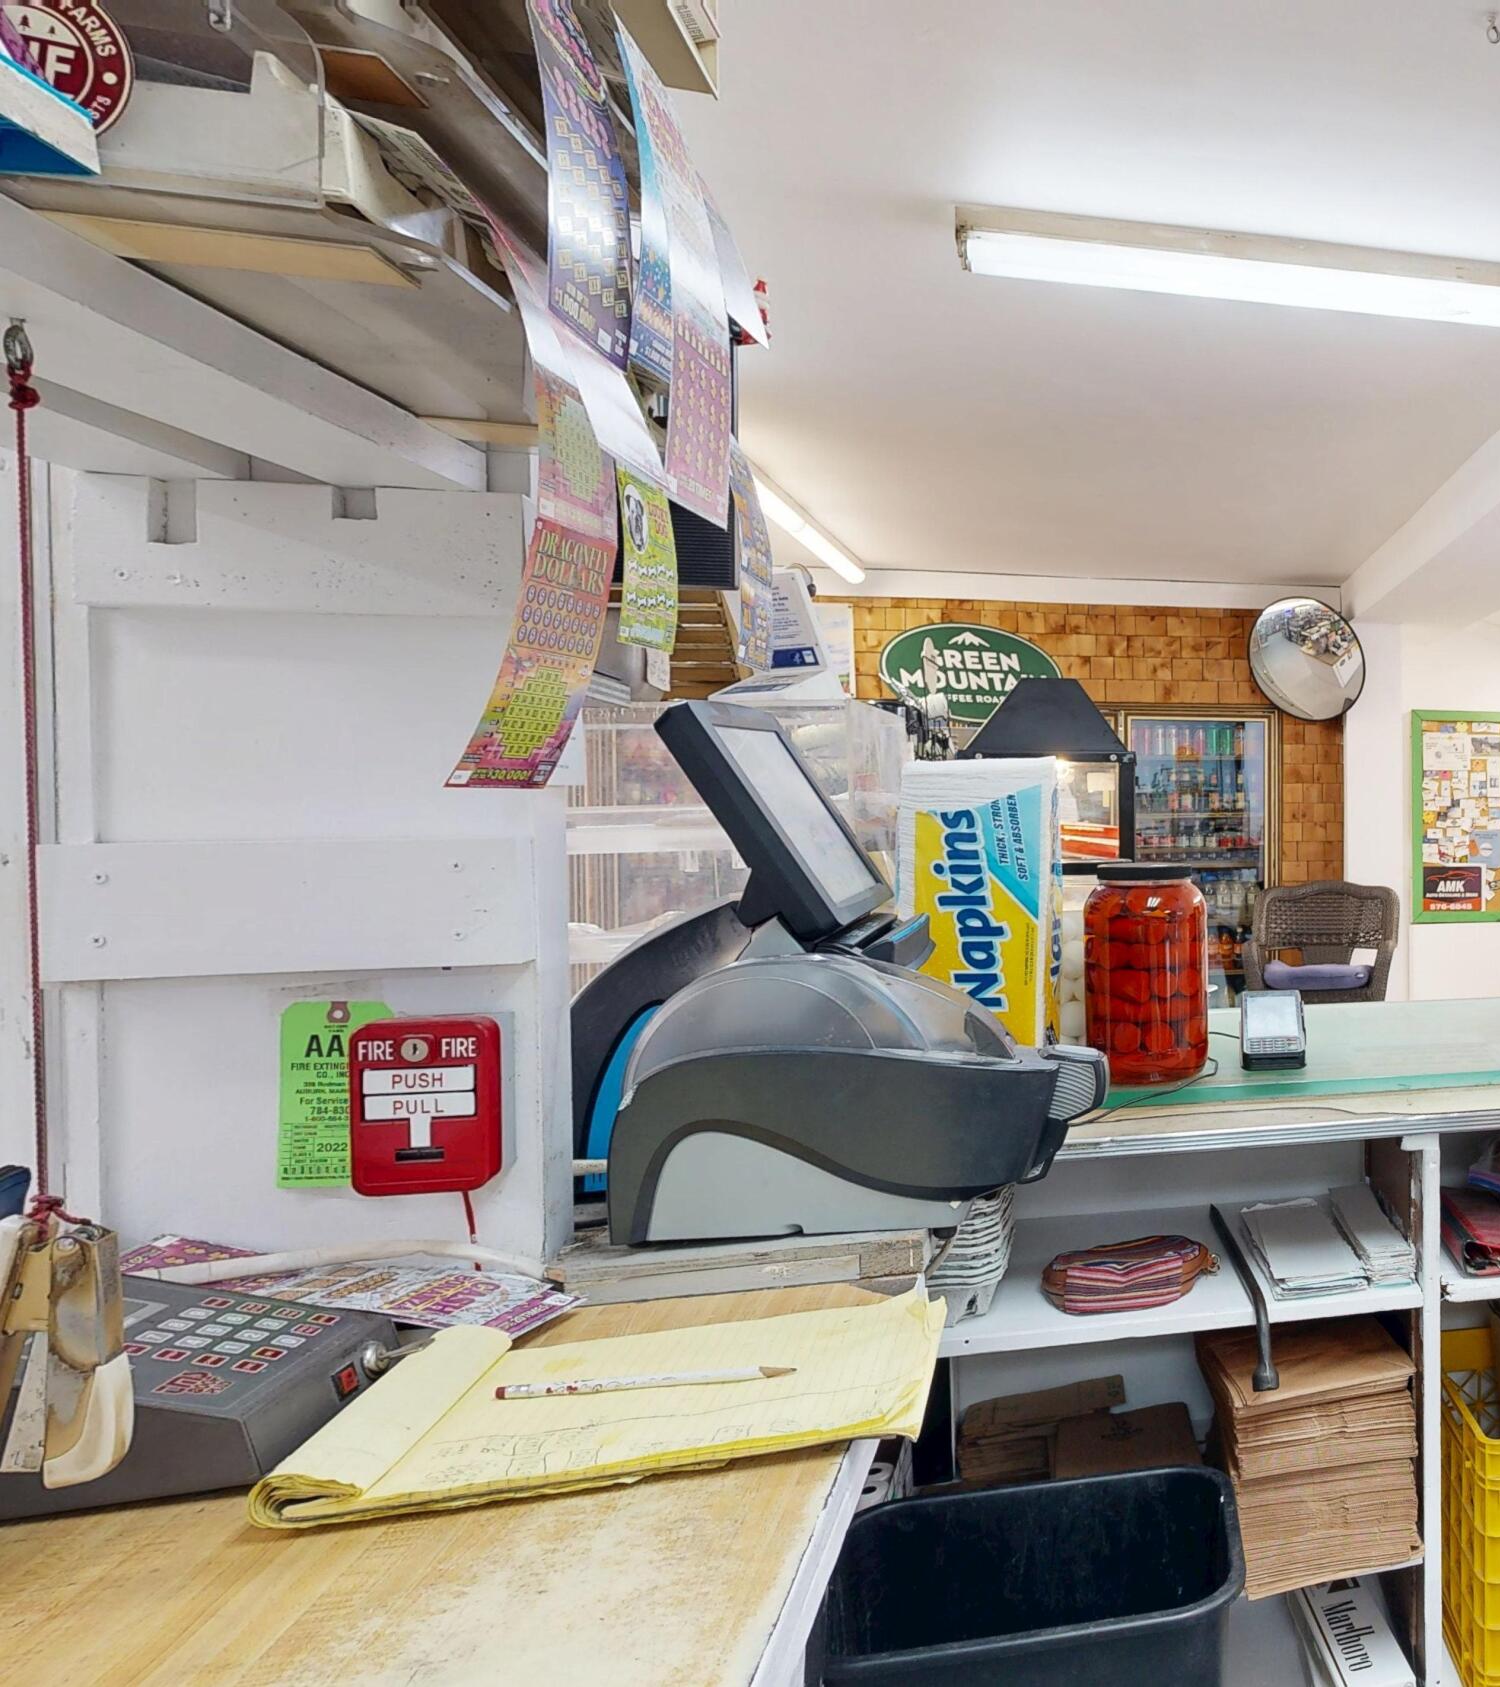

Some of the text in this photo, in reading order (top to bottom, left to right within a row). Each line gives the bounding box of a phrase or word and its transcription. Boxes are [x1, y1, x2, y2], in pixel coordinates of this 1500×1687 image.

[538, 529, 608, 573] DRAGONFLY
[531, 552, 606, 596] DOLLARS
[900, 667, 1047, 692] MOUNTA
[1014, 857, 1028, 881] SOFT
[1436, 880, 1465, 893] AMK
[933, 808, 1005, 1008] Napkins
[304, 1034, 345, 1058] AA
[358, 1038, 477, 1061] FIRE FIRE
[291, 1062, 311, 1071] FIRE
[391, 1072, 444, 1089] PUSH
[300, 1097, 349, 1105] For Service
[392, 1098, 445, 1115] PULL
[316, 1142, 348, 1152] 2022
[1321, 1600, 1375, 1672] Marlboro
